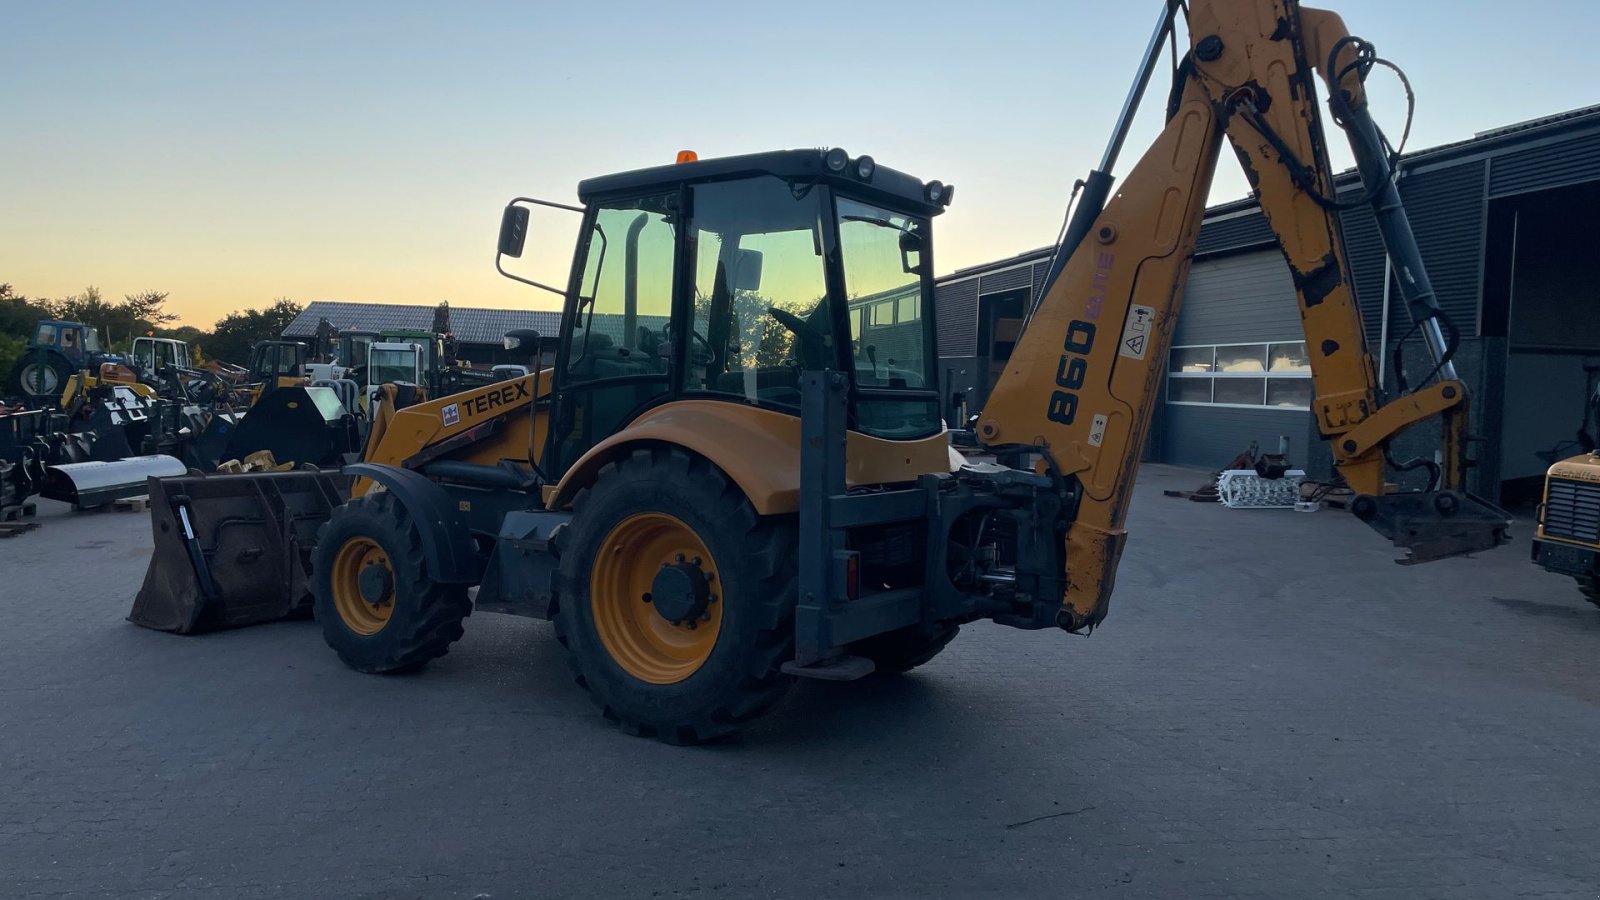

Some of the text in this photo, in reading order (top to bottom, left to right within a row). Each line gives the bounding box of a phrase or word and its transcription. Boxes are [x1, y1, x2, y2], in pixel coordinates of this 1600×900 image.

[1047, 252, 1115, 426] 860 ELITE
[462, 380, 529, 417] TEREX
